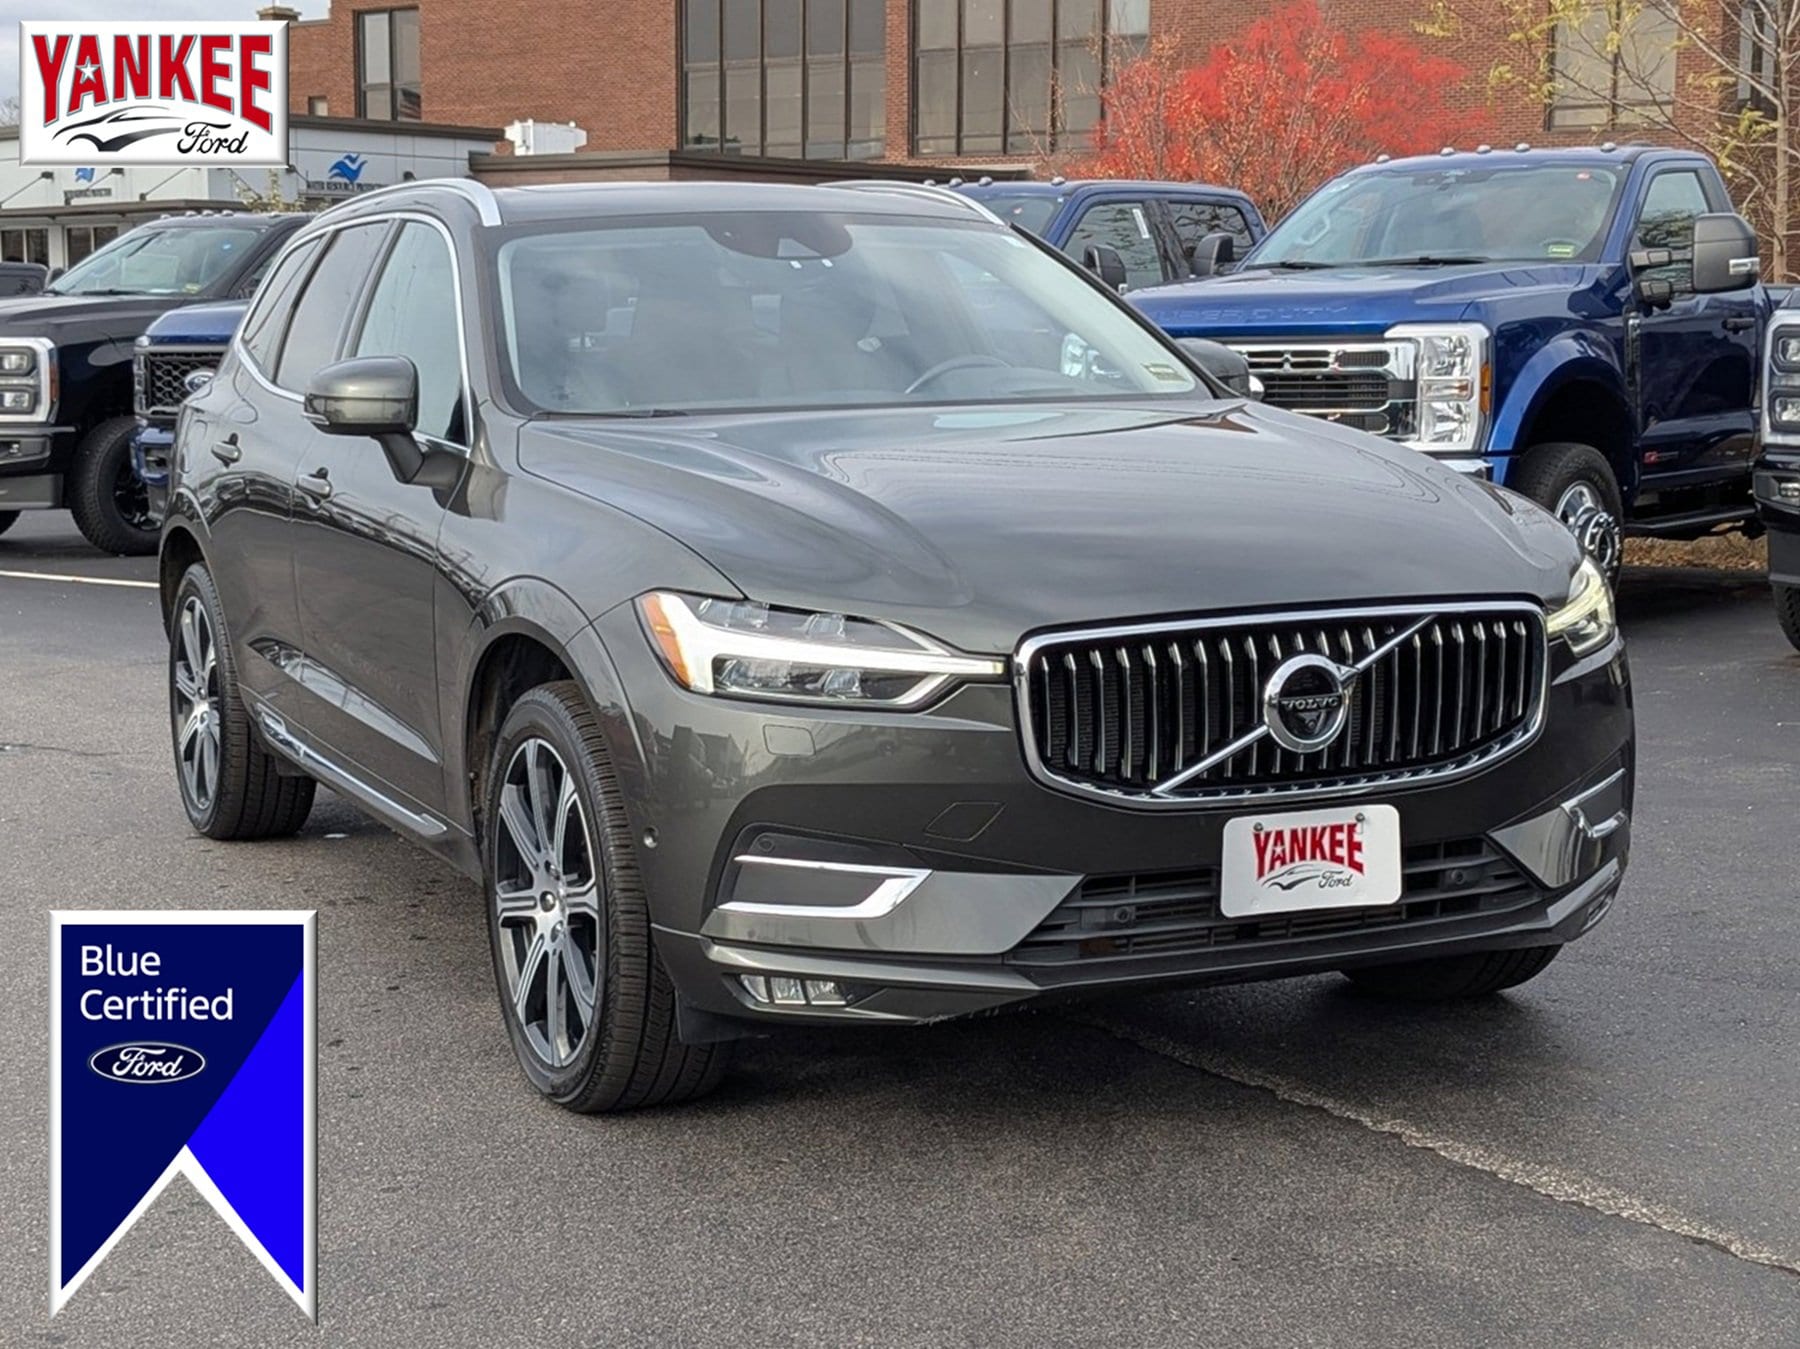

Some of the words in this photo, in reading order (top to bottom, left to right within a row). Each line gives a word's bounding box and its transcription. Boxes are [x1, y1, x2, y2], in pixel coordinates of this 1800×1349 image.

[1280, 696, 1339, 710] VOLVO
[1253, 822, 1365, 881] YANKEE
[1318, 870, 1354, 889] Ford
